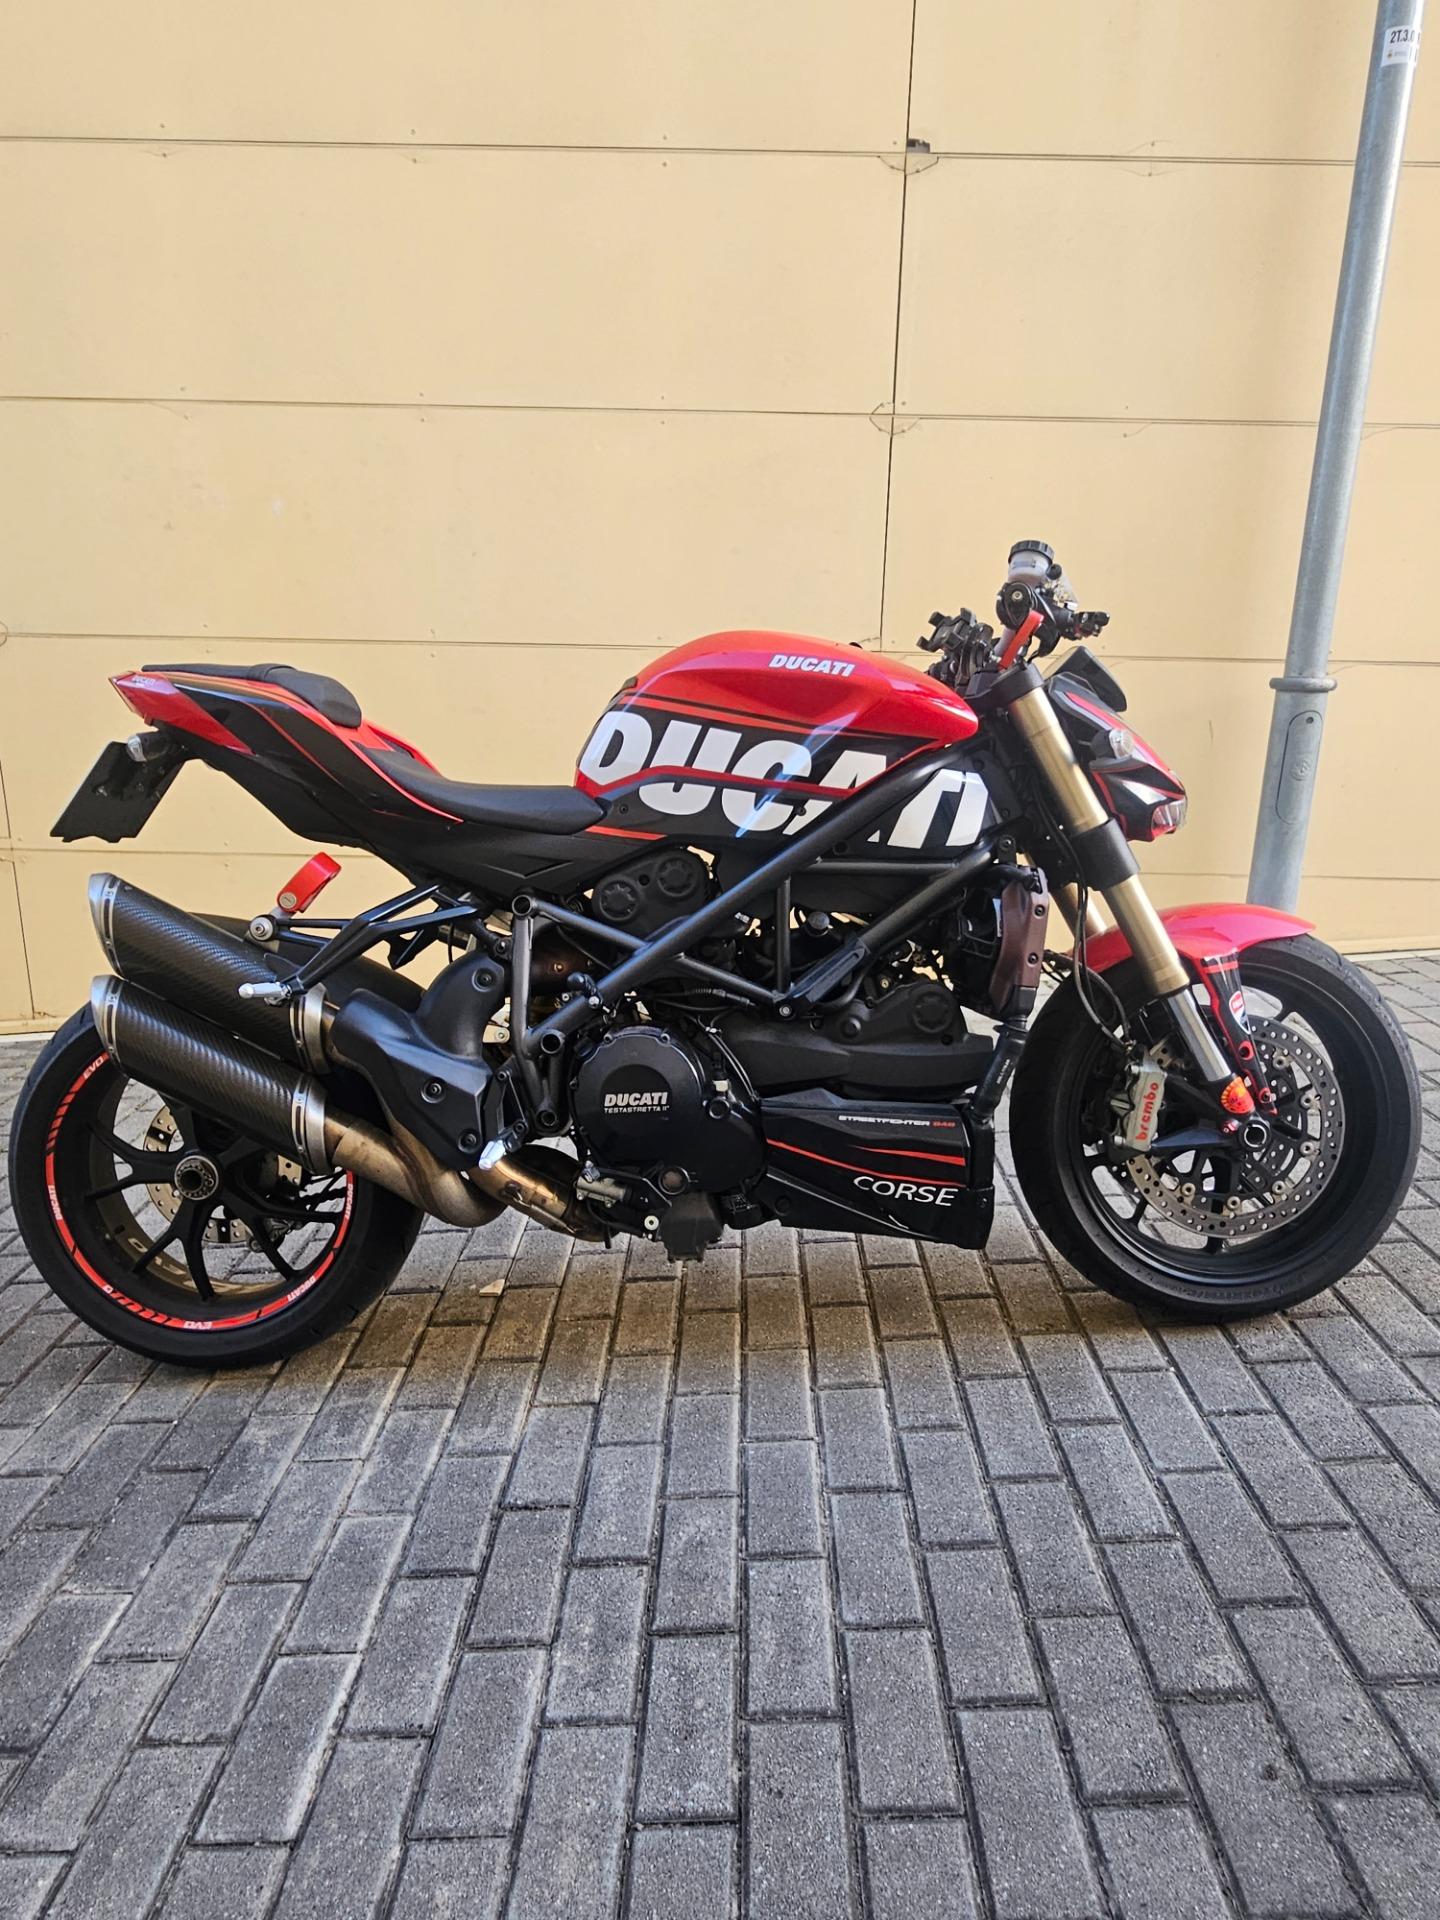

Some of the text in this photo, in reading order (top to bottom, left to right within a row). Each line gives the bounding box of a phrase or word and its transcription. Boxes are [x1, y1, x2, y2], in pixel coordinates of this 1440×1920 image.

[768, 654, 855, 677] DUCATI
[83, 1055, 104, 1079] EVO
[604, 1092, 668, 1107] DUCATI
[604, 1106, 661, 1114] TESTASTRETTA
[1135, 1082, 1159, 1141] brembo
[345, 1183, 354, 1220] DUCATI
[853, 1176, 958, 1206] CORSE
[287, 1275, 316, 1302] DUCATI
[183, 1321, 213, 1330] EVO
